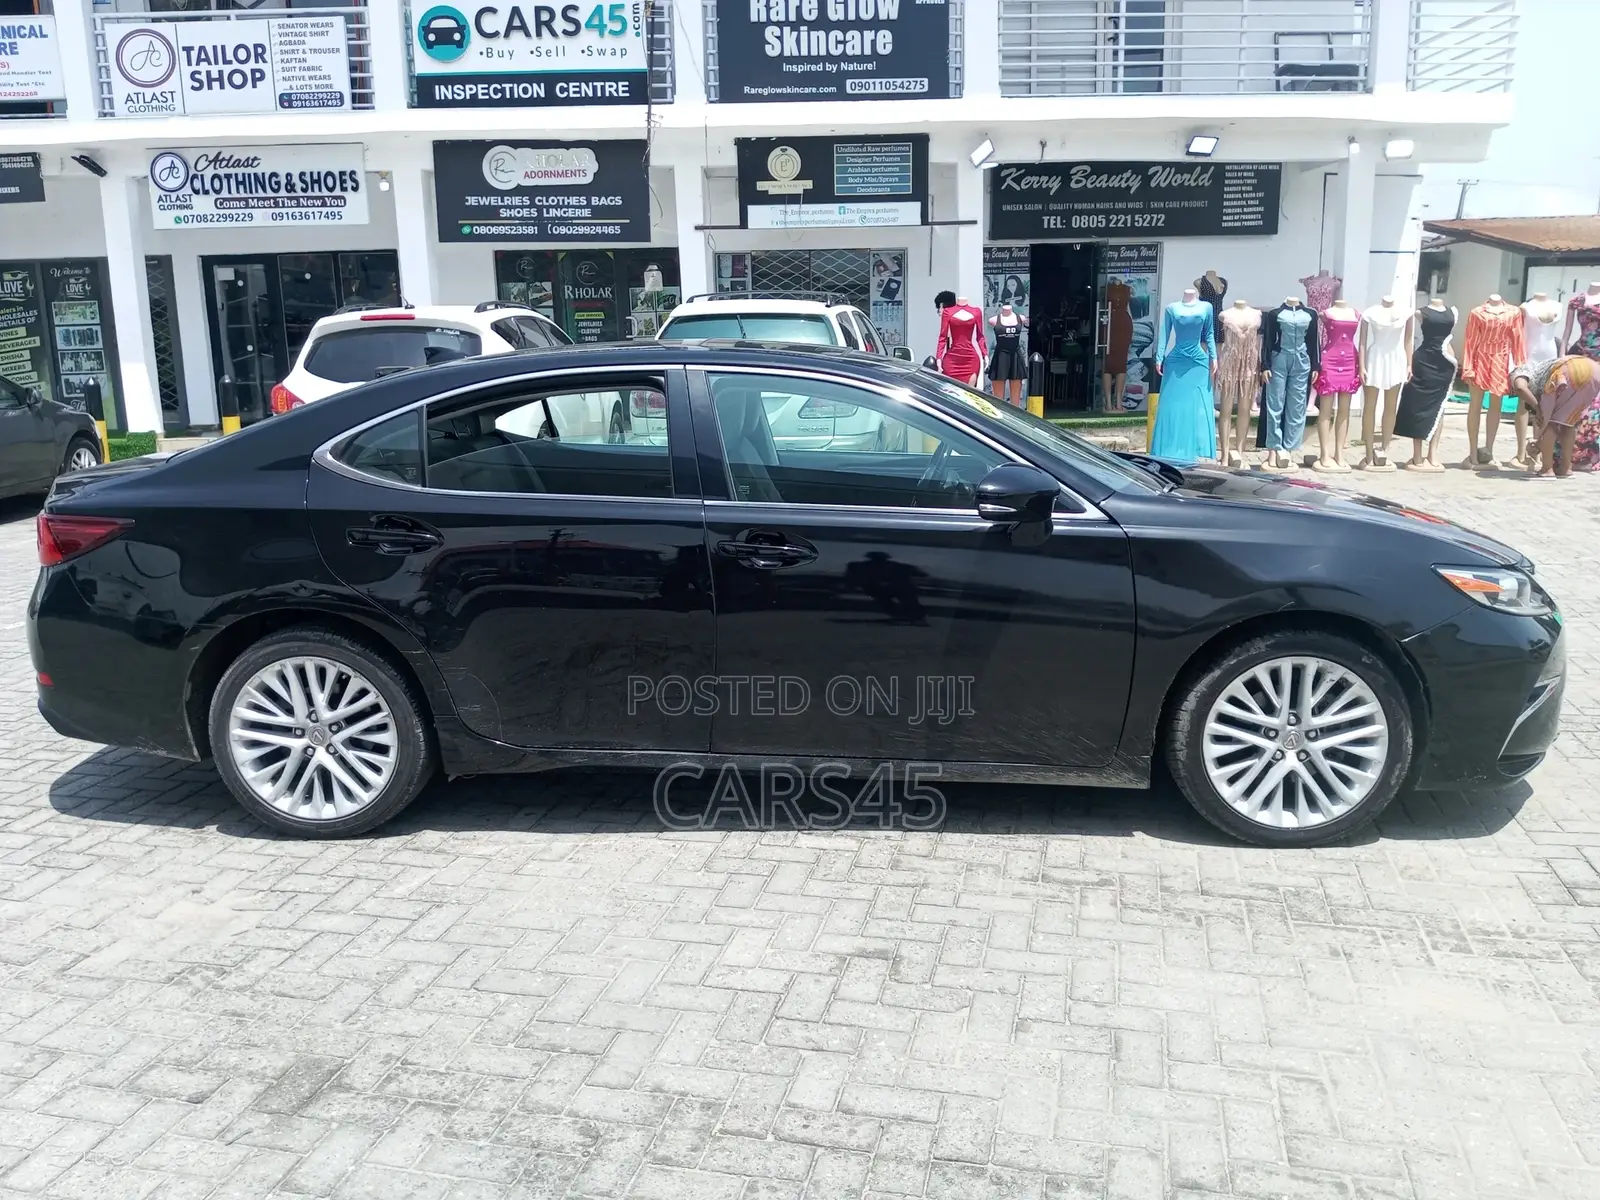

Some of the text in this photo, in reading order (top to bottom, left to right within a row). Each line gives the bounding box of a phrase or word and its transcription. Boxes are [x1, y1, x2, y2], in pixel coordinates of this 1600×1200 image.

[750, 0, 899, 22] Rare Glow
[474, 4, 628, 39] CARS45
[0, 25, 48, 39] NICAL
[764, 25, 893, 58] Skincare
[182, 43, 268, 66] TAILOR
[485, 45, 628, 60] Buy Sell Swap
[783, 61, 876, 73] Inspired by Nature!
[190, 68, 265, 91] SHOP
[435, 82, 630, 100] INSPECTION CENTRE
[744, 85, 837, 96] Rareglowskincare.com
[850, 80, 926, 91] 09011054275
[124, 91, 176, 105] ATLAST
[291, 92, 340, 100] 07082299229
[127, 104, 176, 113] CLOTHING
[292, 99, 341, 107] 09163617495
[881, 145, 909, 153] perfumes
[194, 151, 262, 172] Atlast
[524, 169, 587, 179] ADORNMENTS
[190, 171, 281, 195] CLOTHING
[284, 172, 298, 193] &
[299, 169, 360, 193] SHOES
[1000, 165, 1215, 195] Kerry Beauty World
[157, 193, 193, 204] ATLAST
[216, 197, 345, 208] Come Meet The New You
[465, 196, 623, 206] JEWELRIES CLOTHES BAGS
[158, 203, 194, 211] CLOTHING
[1128, 201, 1144, 209] WIGS
[182, 211, 343, 224] 07082299229 09163617495
[499, 208, 592, 217] SHOES LINGERIE
[1042, 213, 1165, 228] TEL: 0805 221 5272
[473, 225, 538, 235] 08069523581
[992, 248, 1010, 260] Beauty
[1012, 247, 1029, 258] World
[1120, 246, 1138, 260] Beauty
[1140, 246, 1157, 256] World
[0, 281, 24, 293] LOVE
[66, 283, 84, 293] LOVE
[564, 284, 613, 300] RHOLAR
[0, 310, 38, 320] HOLESALES
[0, 339, 37, 349] BEVERAGES
[0, 353, 25, 361] SHISHA
[2, 364, 26, 372] MIXERS
